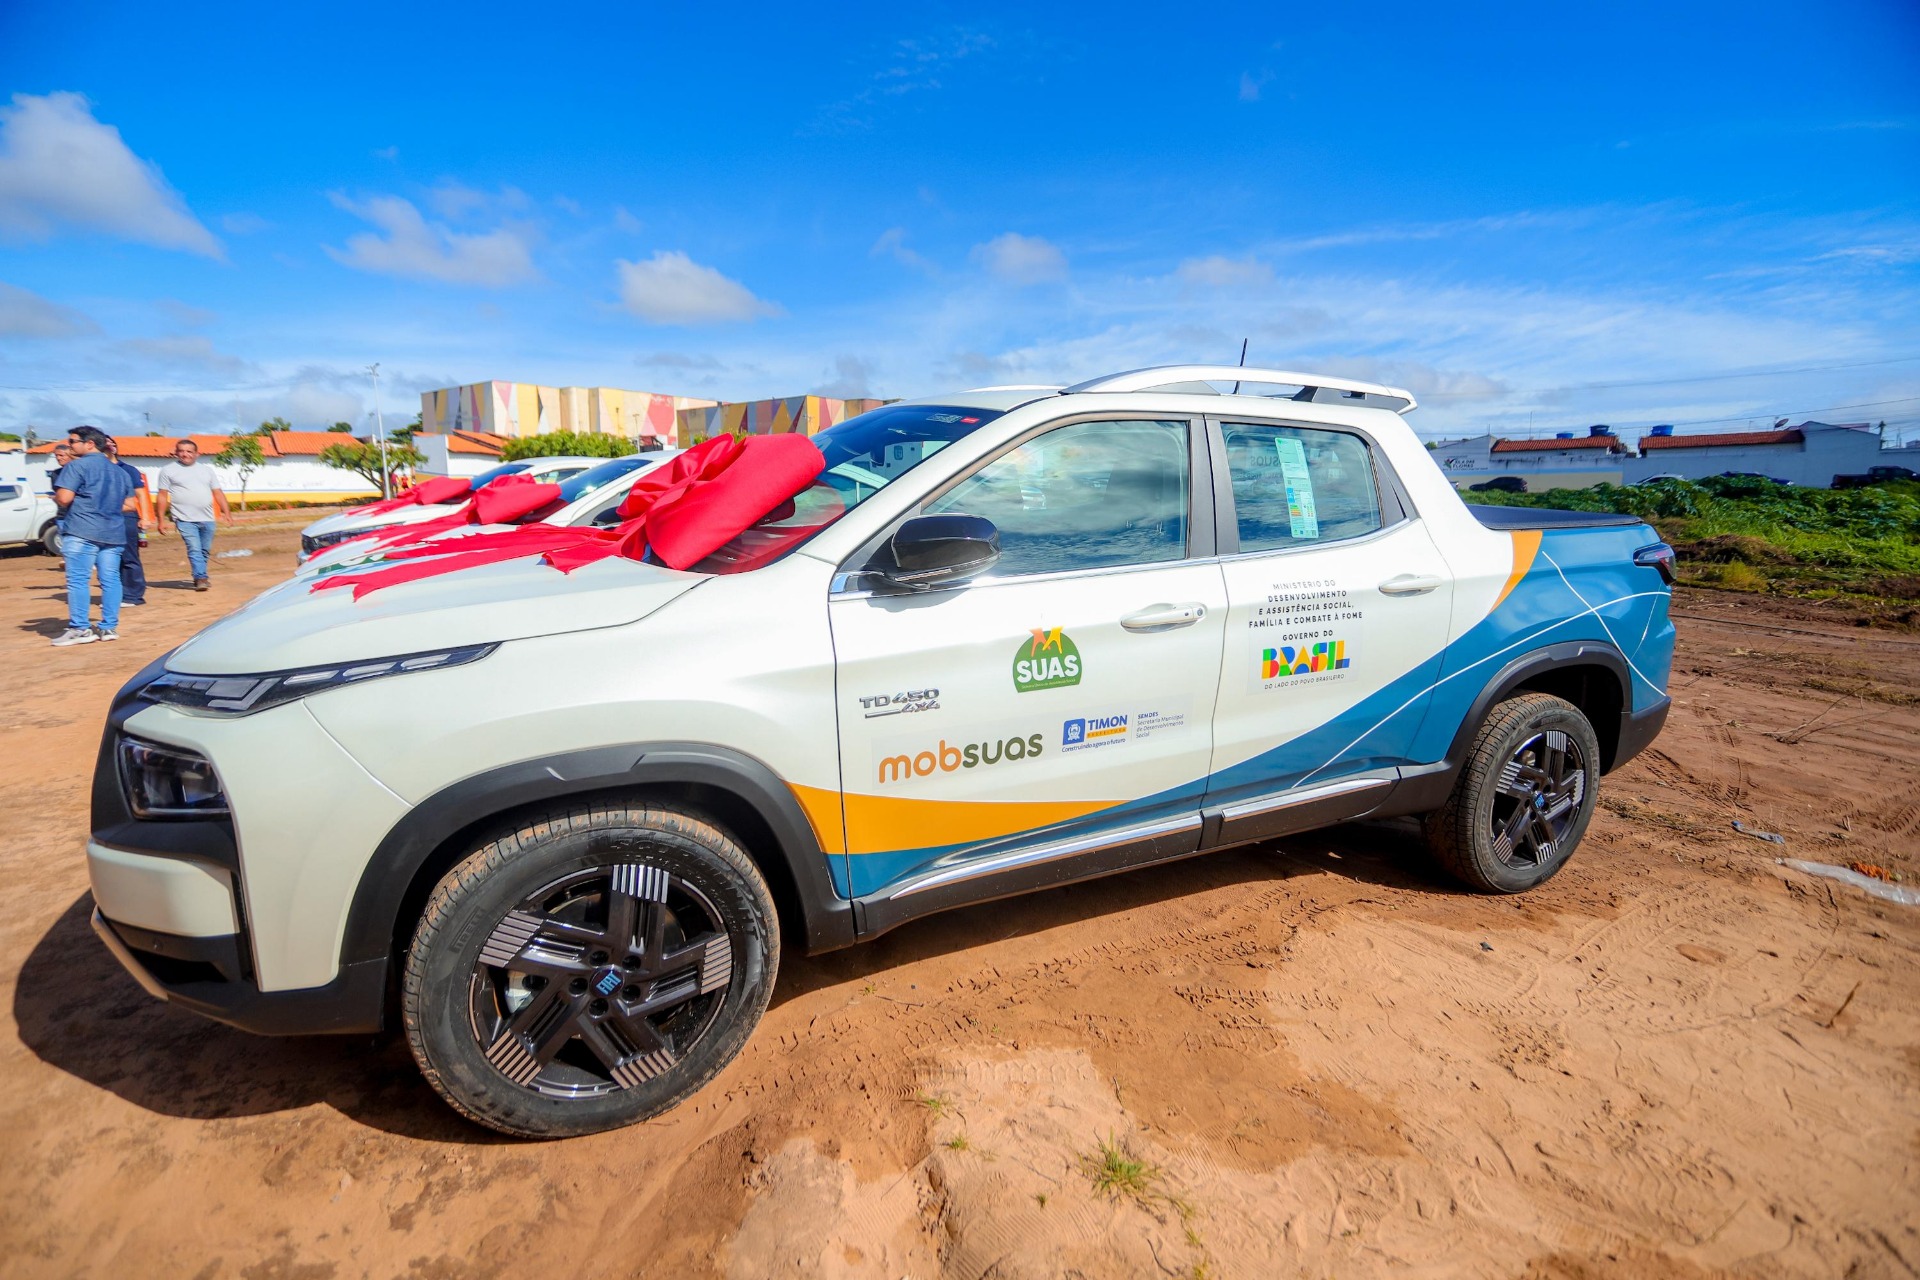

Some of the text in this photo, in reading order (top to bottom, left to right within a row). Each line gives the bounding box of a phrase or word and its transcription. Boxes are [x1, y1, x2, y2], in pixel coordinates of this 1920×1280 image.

[1324, 579, 1336, 587] DO
[1268, 590, 1347, 602] DESENVOLVIMENTO
[1266, 603, 1320, 615] ASSISTÊNCIA
[1248, 618, 1283, 629] FAMÍLIA
[1286, 617, 1291, 625] E
[1293, 614, 1332, 624] COMBATE
[1342, 611, 1363, 620] FOME
[1282, 629, 1334, 641] GOVERNO DO
[1016, 654, 1079, 683] SUAS
[1261, 640, 1351, 680] BRASIL
[1274, 681, 1289, 689] LADO
[1300, 677, 1315, 685] POVO
[1316, 673, 1345, 683] BRASILEIRO
[1087, 714, 1128, 731] TIMON
[878, 733, 1043, 783] mobsuas
[595, 972, 622, 995] FIAT
